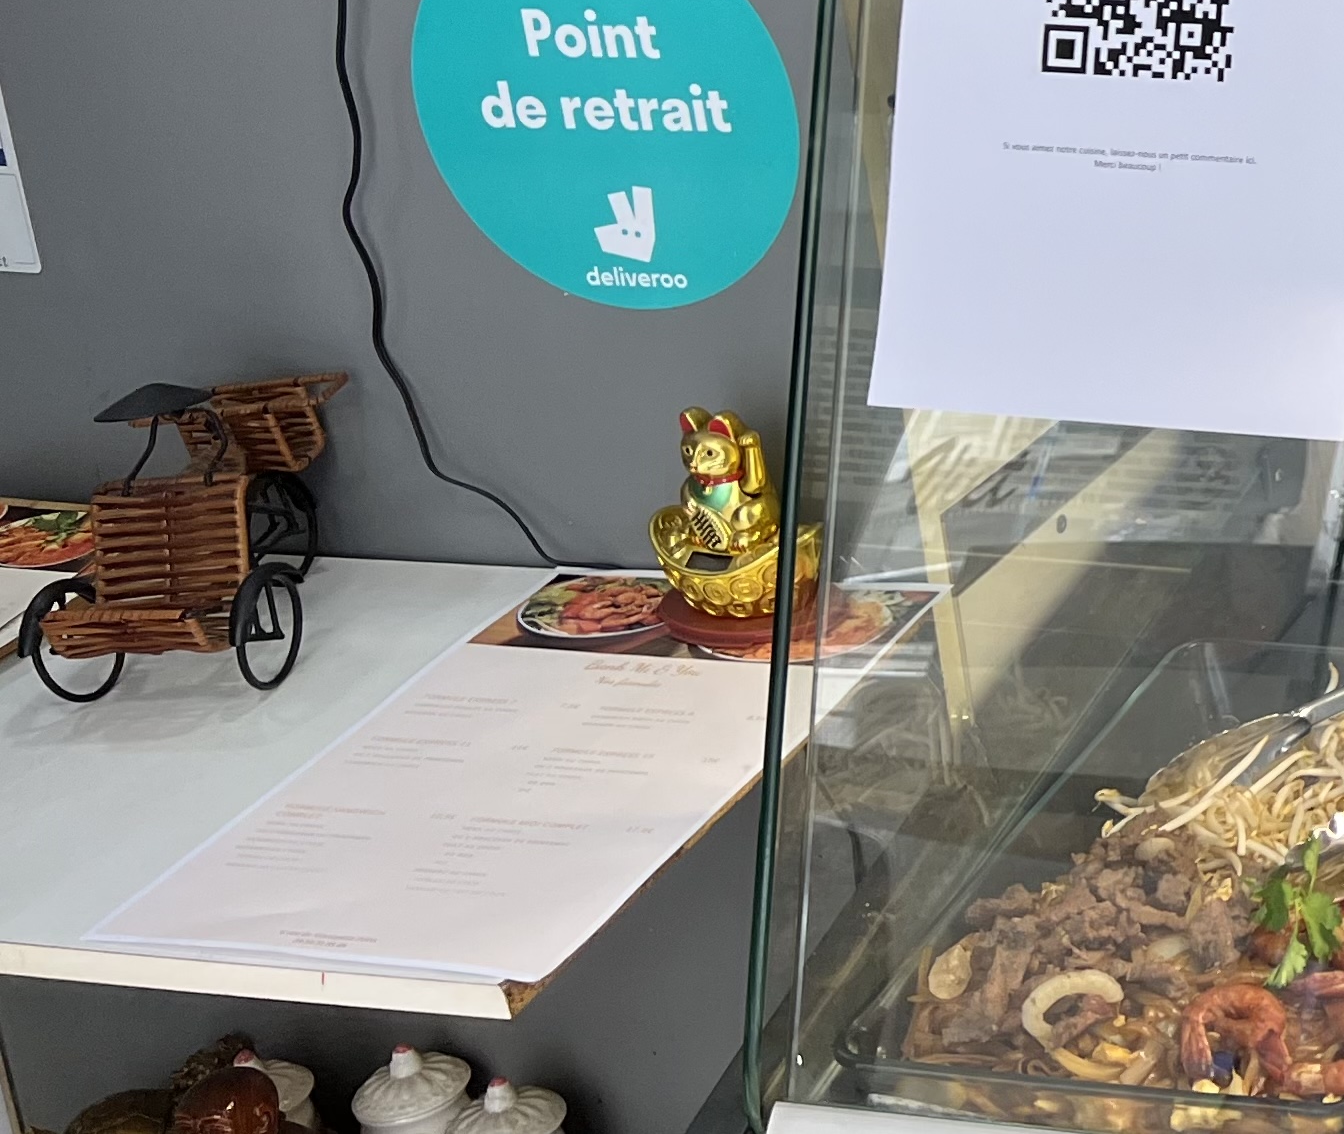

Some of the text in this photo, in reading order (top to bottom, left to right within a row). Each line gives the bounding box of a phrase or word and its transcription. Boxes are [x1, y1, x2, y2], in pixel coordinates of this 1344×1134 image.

[520, 8, 661, 59] Point
[480, 80, 733, 133] de retrait
[1056, 145, 1078, 154] notre
[1170, 151, 1189, 162] petit
[1190, 153, 1244, 165] commentaire
[1118, 160, 1157, 172] beaucoup
[585, 266, 688, 290] deliveroo
